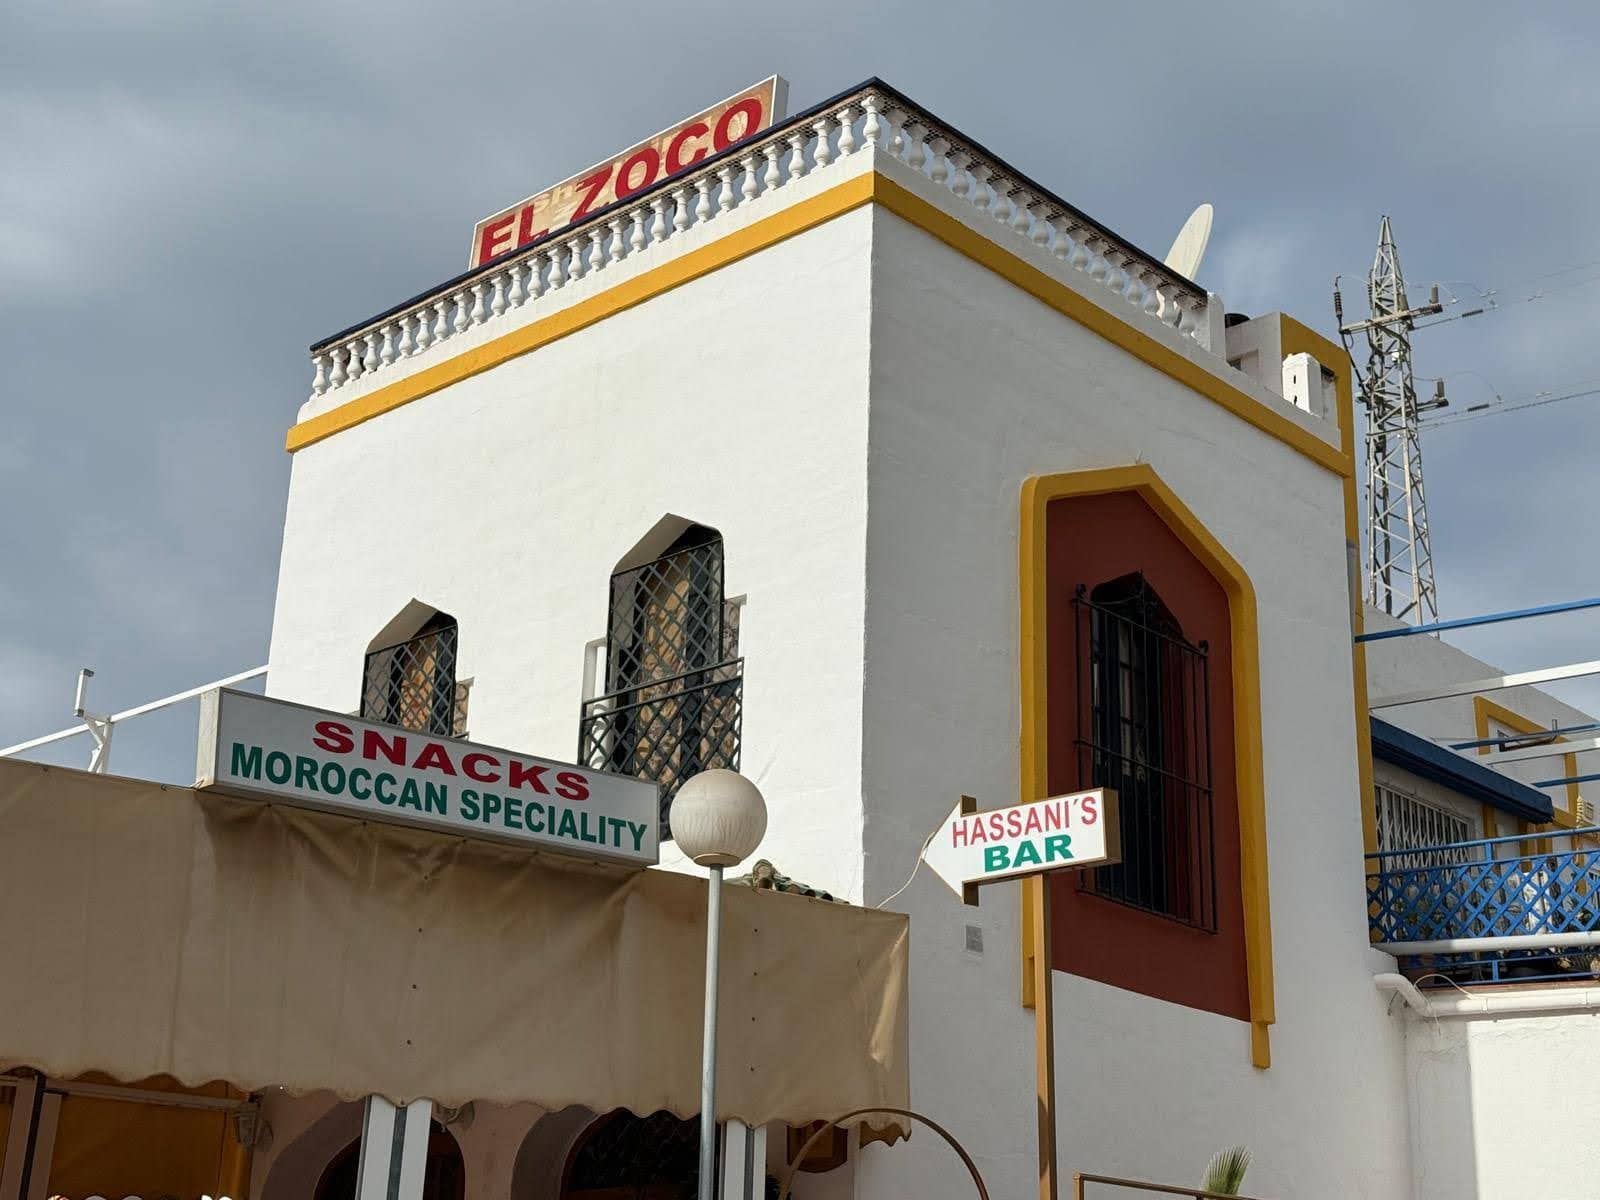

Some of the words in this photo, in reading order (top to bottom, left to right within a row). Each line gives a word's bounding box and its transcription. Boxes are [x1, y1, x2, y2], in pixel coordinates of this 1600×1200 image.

[479, 203, 549, 266] EL
[570, 98, 763, 225] ZOCO
[231, 742, 448, 816] MOROCCAN
[460, 789, 648, 851] SPECIALITY
[312, 721, 590, 801] SNACKS
[952, 796, 1098, 848] HASSANI'S
[984, 834, 1074, 872] BAR
